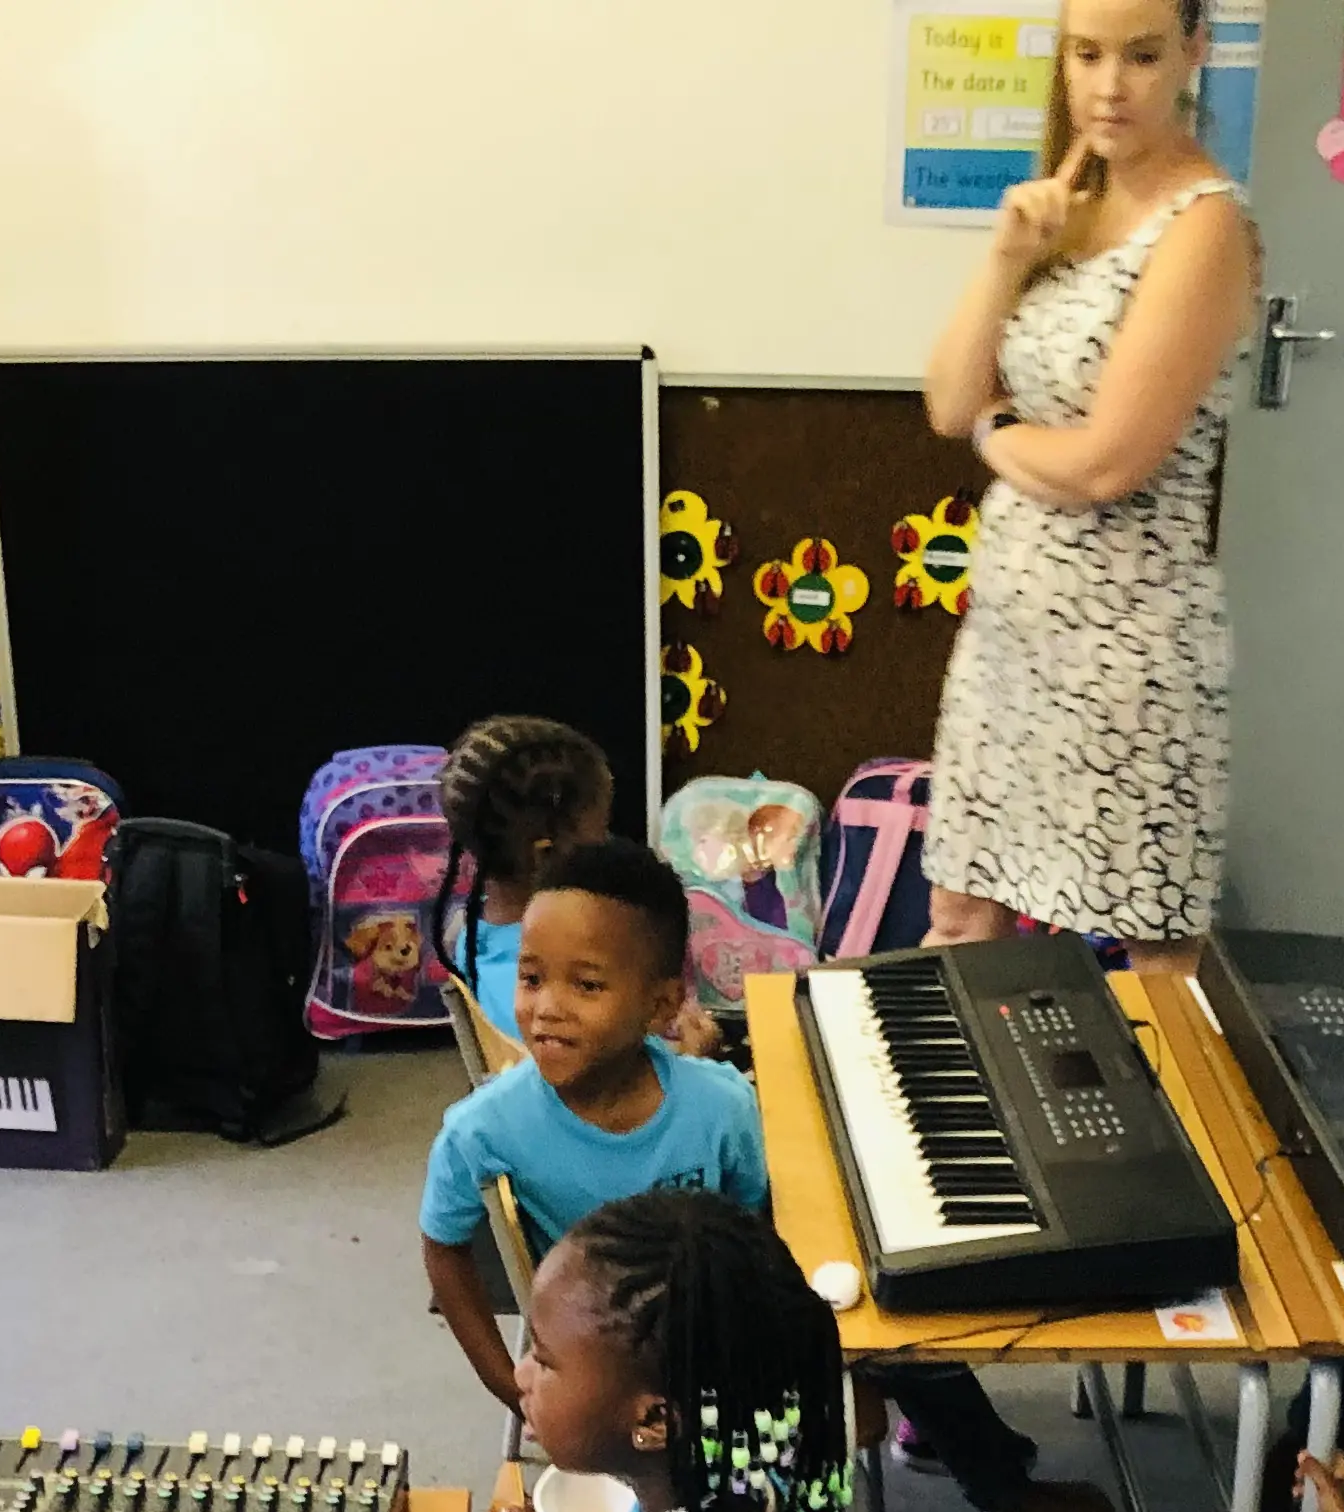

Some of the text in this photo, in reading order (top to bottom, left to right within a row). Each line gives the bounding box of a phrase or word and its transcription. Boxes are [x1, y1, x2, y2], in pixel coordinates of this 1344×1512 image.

[924, 26, 1003, 56] Today is
[921, 69, 1028, 93] The date is
[916, 167, 1029, 190] The weathe
